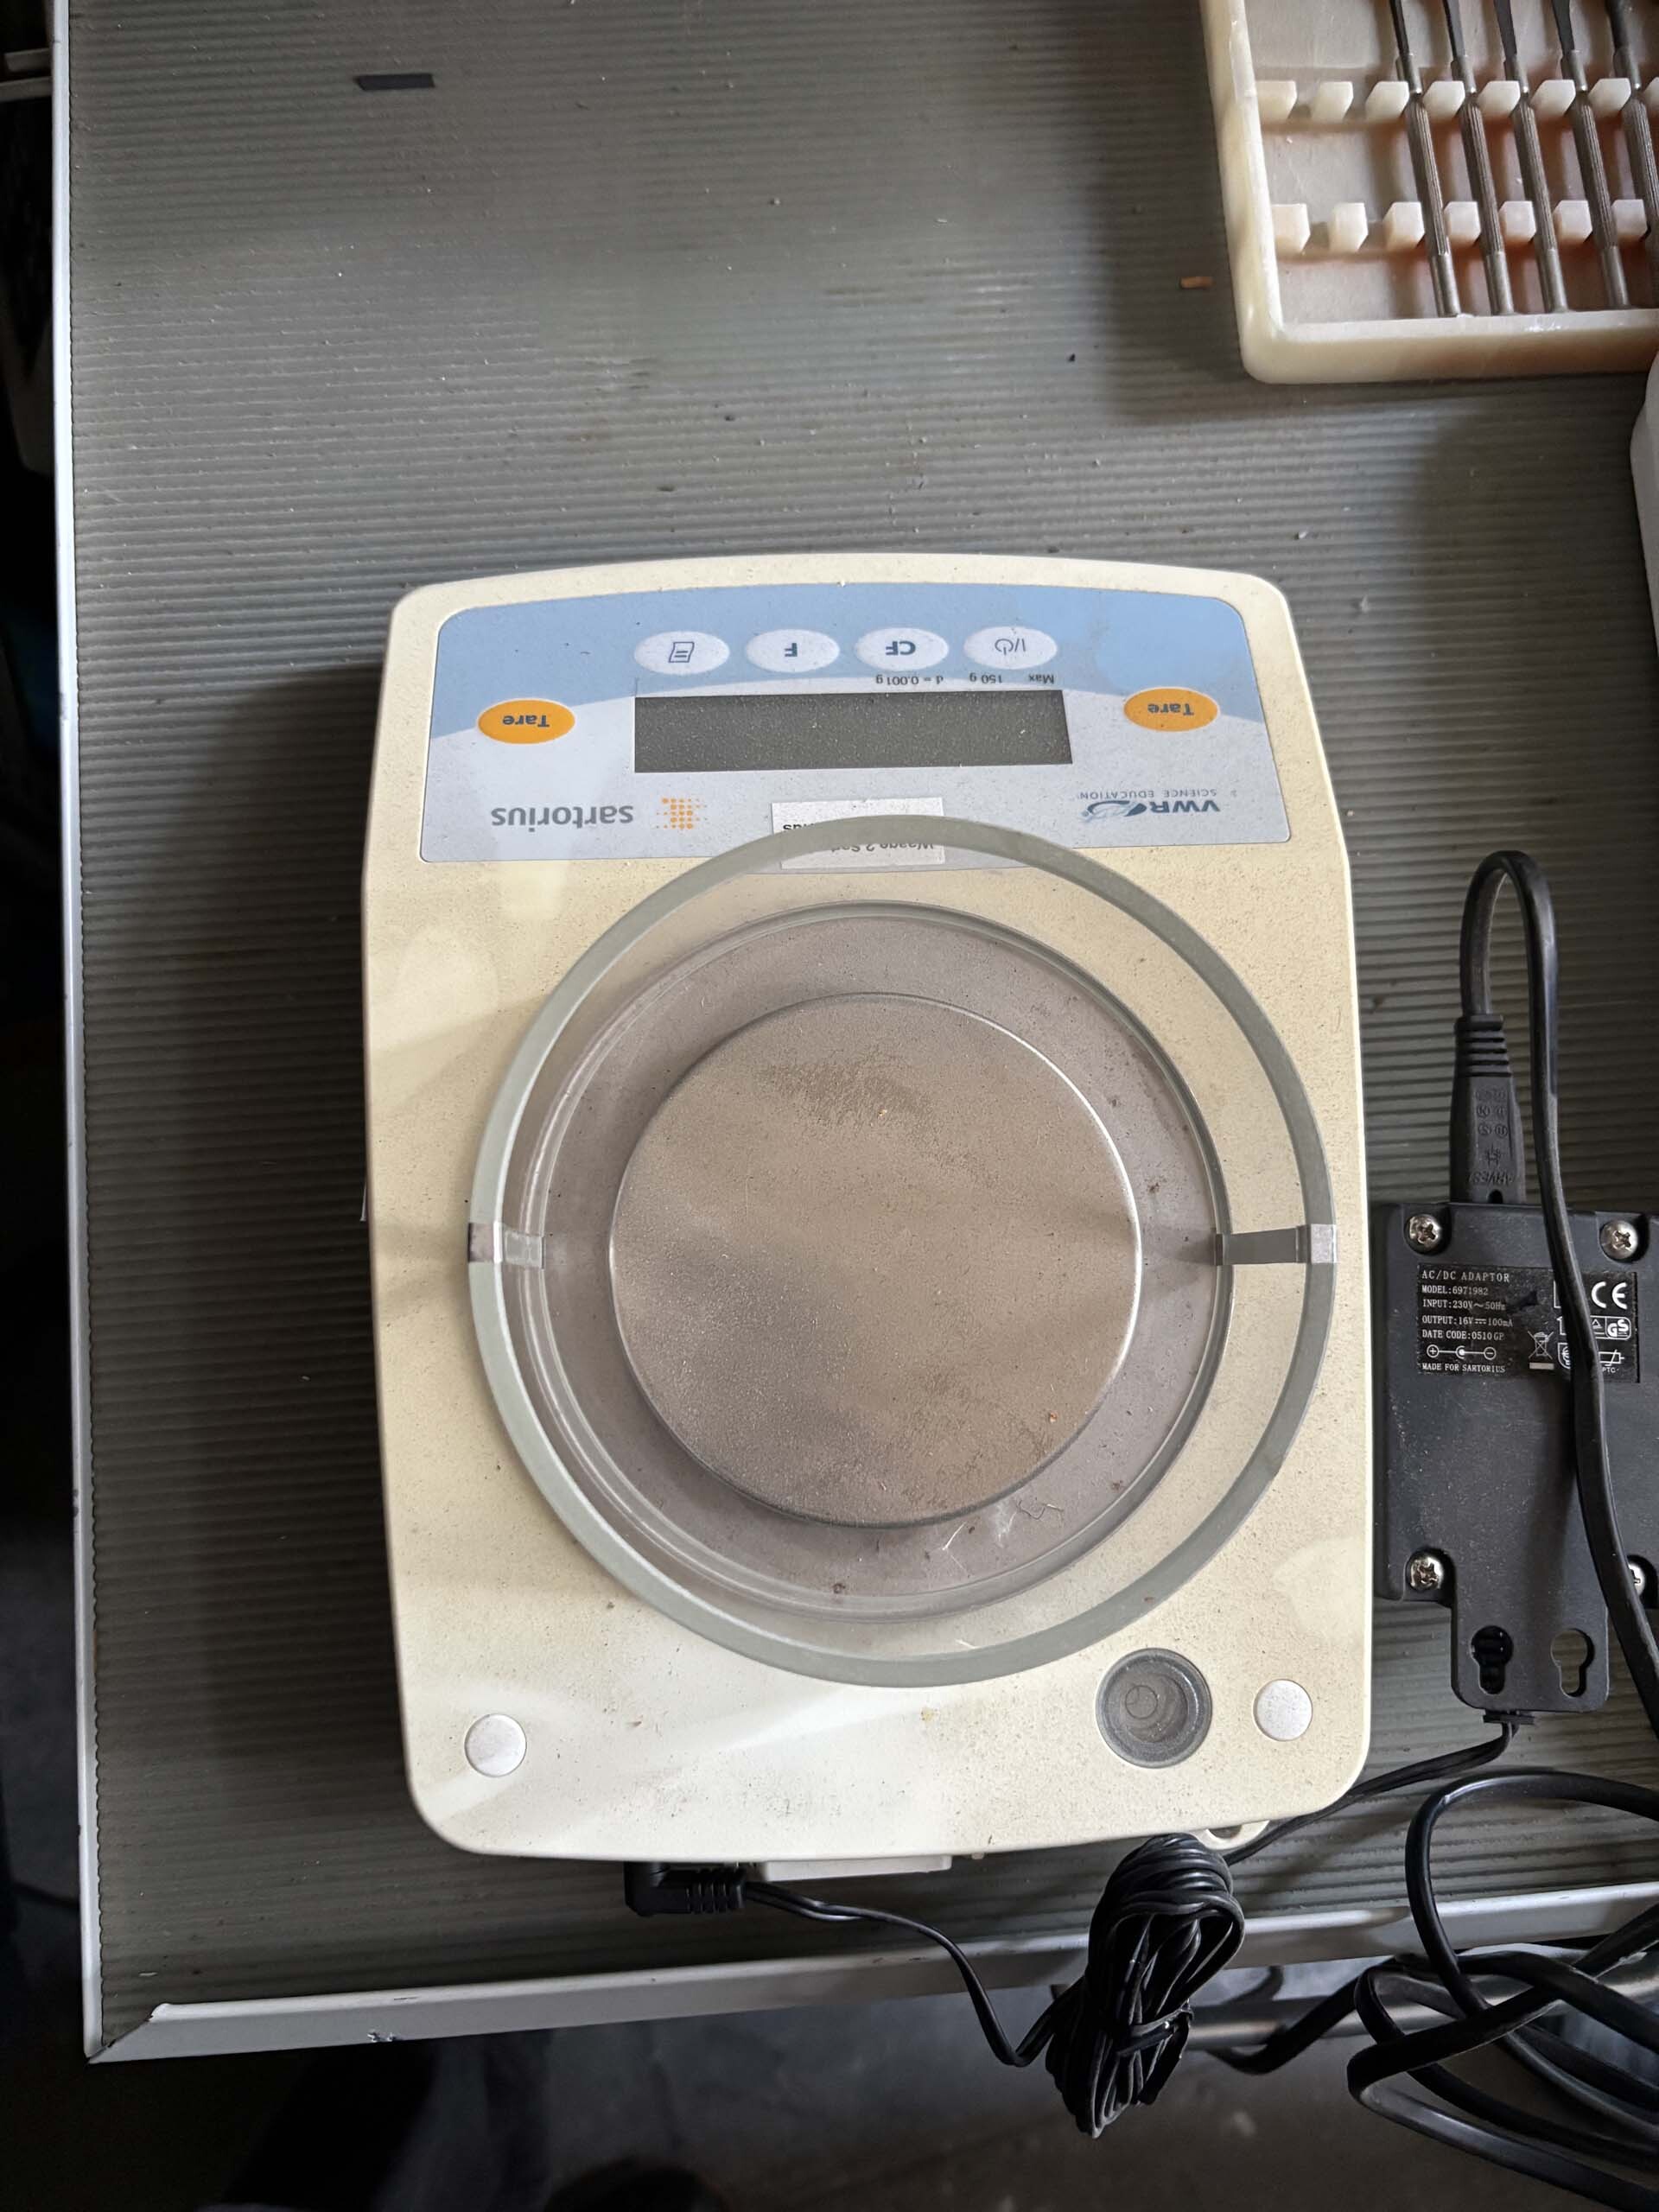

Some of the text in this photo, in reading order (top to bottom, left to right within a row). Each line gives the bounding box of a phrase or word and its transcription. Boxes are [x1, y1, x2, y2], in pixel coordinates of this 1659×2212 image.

[784, 642, 798, 658] F
[885, 640, 917, 656] CF
[887, 675, 919, 685] 0.001
[981, 674, 1003, 684] 150
[1028, 673, 1055, 684] Max
[1147, 702, 1195, 715] Tare
[501, 714, 550, 728] Tare
[1080, 788, 1217, 800] SCIENCE EDUCATION
[1148, 799, 1221, 813] VWR
[490, 804, 634, 832] sartorius
[1421, 1270, 1510, 1283] AC/DC ADAPTOR
[1421, 1329, 1444, 1339] DATE
[1422, 1363, 1442, 1371] MADE
[1462, 1364, 1506, 1374] SARTORIUS
